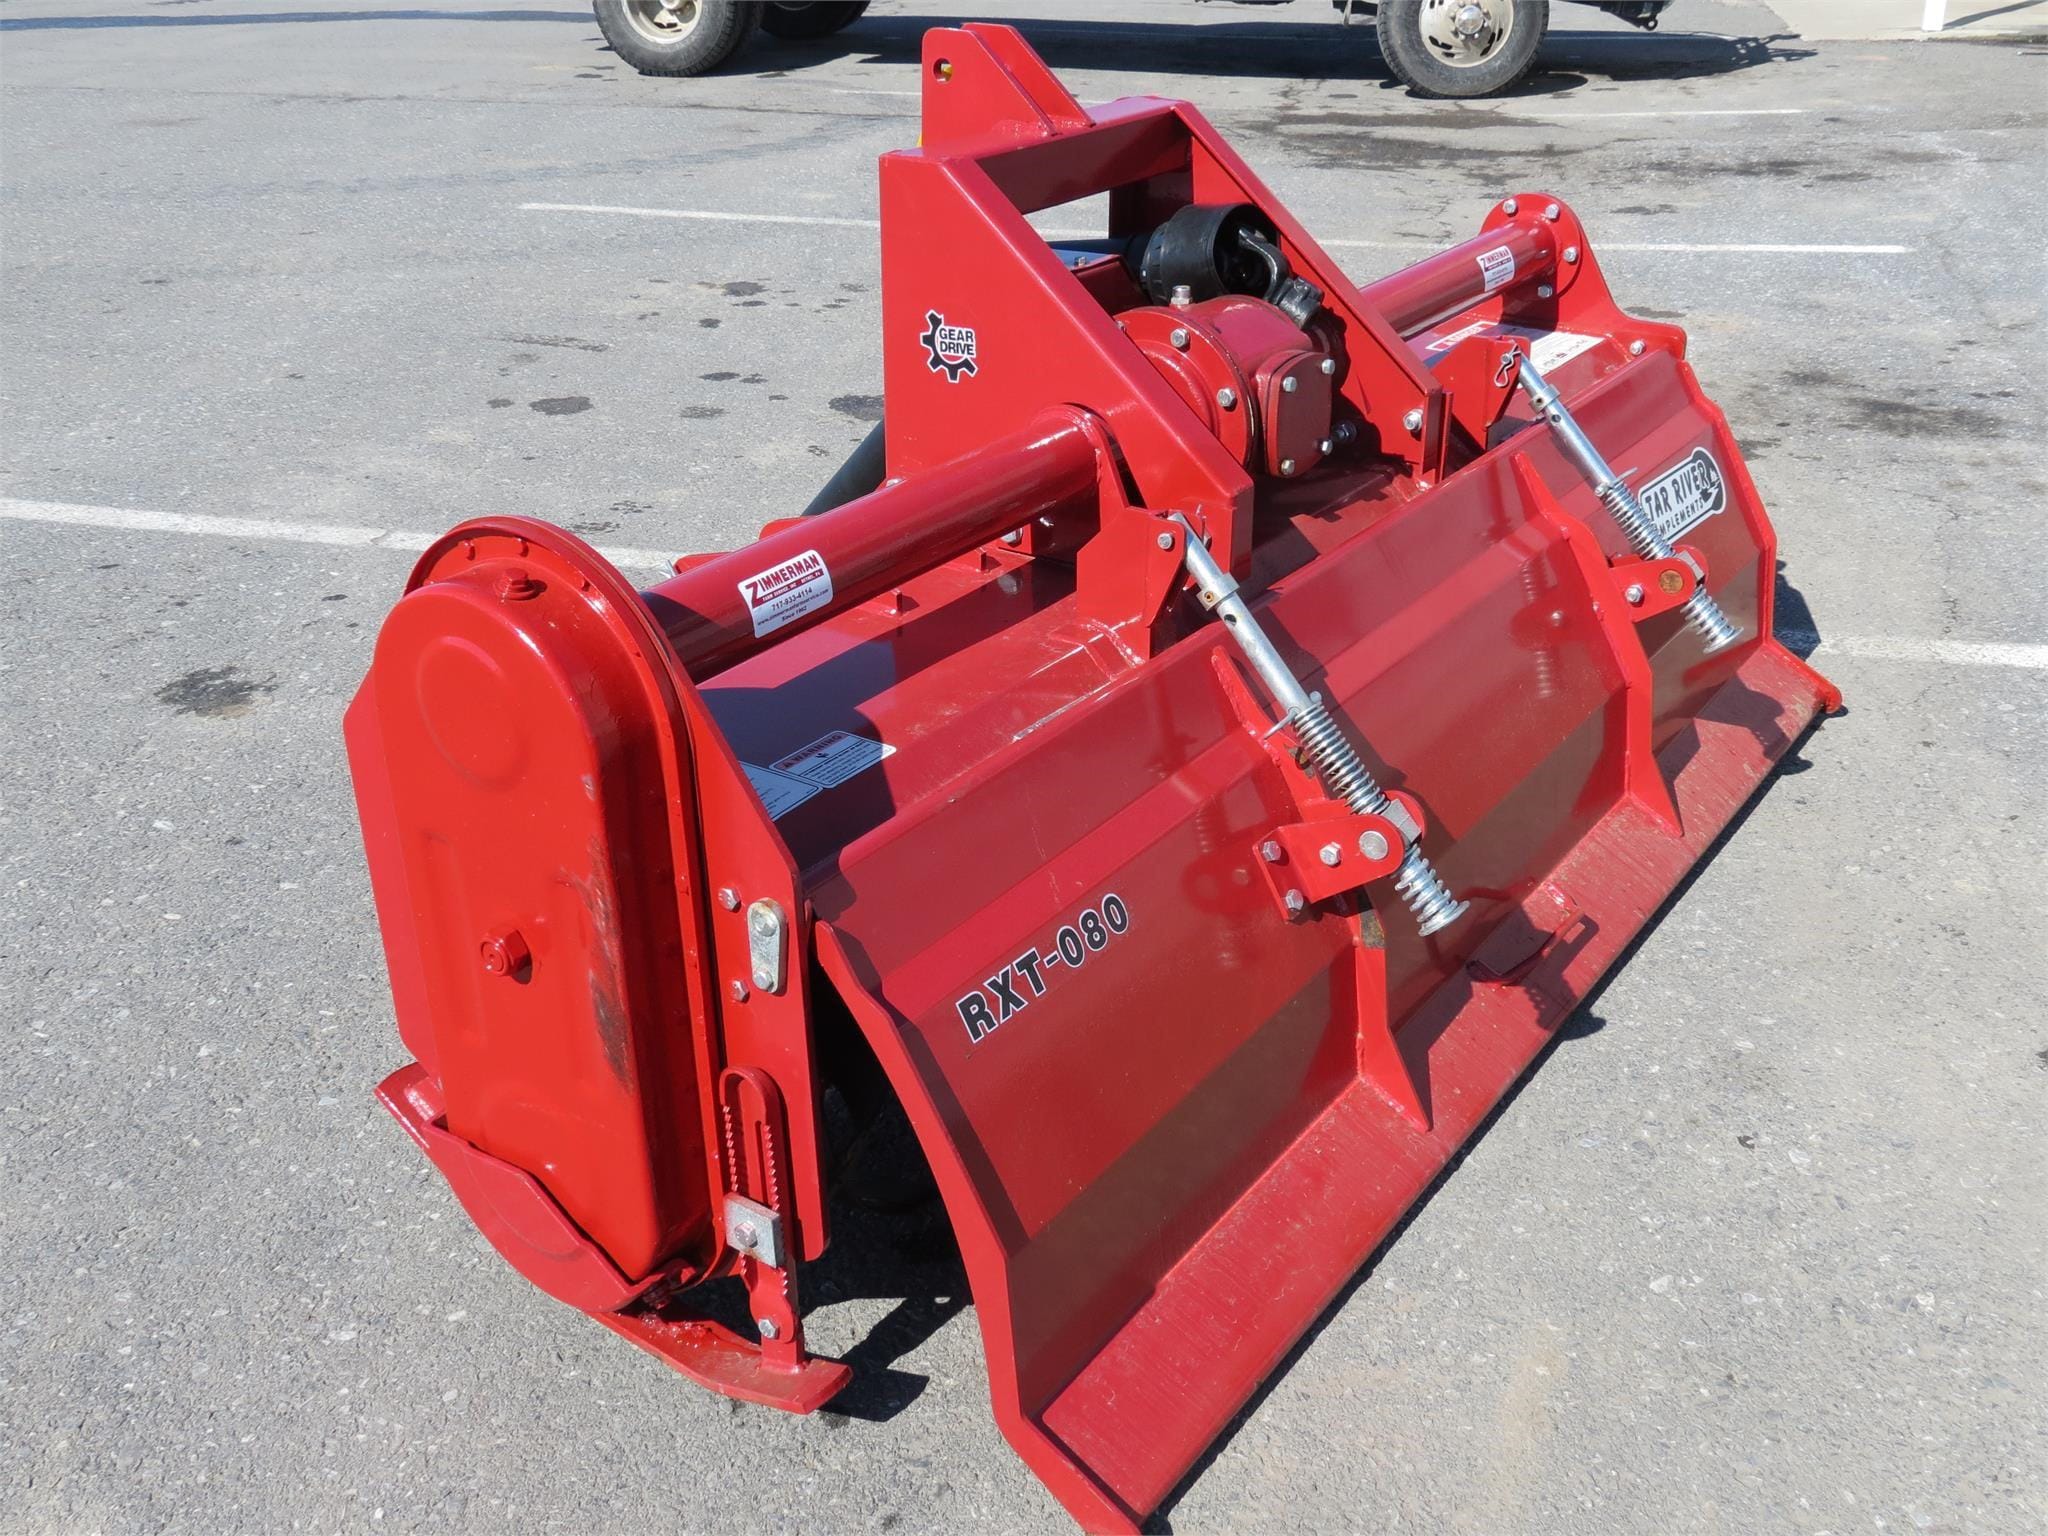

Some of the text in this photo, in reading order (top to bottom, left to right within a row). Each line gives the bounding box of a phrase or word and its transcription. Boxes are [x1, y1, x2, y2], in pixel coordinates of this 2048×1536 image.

[939, 327, 974, 343] GEAR
[940, 341, 974, 356] DRIVE
[1645, 462, 1710, 521] TAR RIVER
[1658, 496, 1704, 536] MPLEMENTS
[745, 554, 820, 608] ZIMMERMAN
[771, 587, 813, 611] 717-933-4114
[792, 733, 843, 764] WARNING
[955, 893, 1128, 1044] RXT-080
